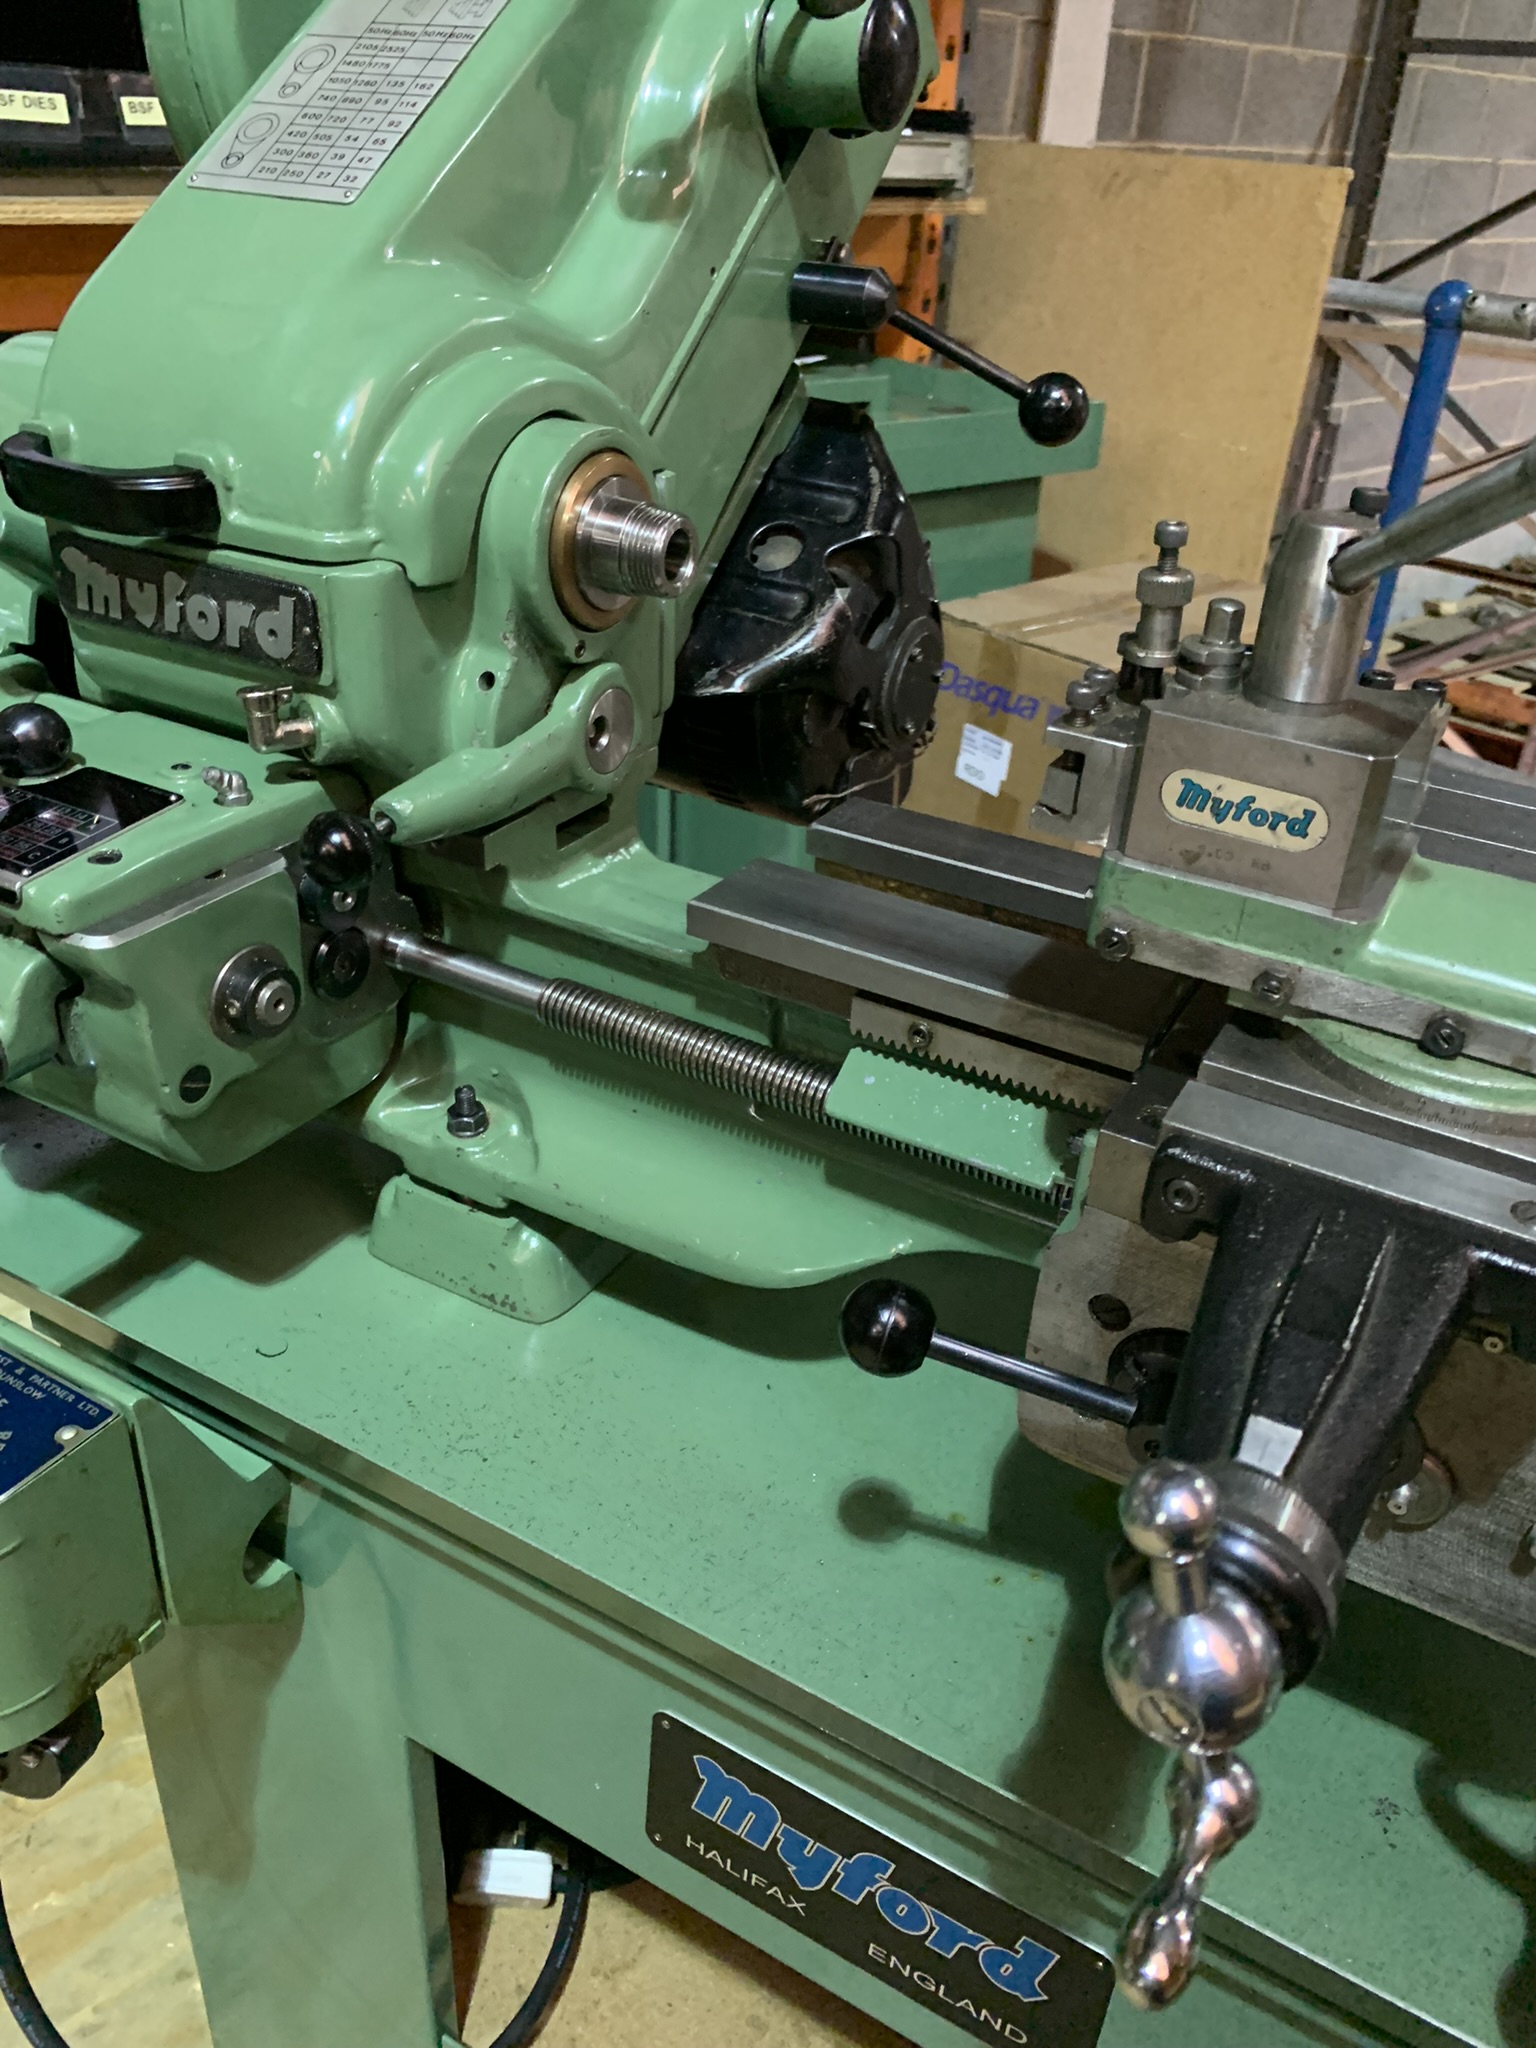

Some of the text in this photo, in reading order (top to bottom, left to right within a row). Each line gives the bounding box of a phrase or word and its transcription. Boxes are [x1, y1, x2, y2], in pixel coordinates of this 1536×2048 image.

[355, 43, 406, 54] 2105 2525
[342, 59, 391, 70] 1480 1775
[328, 77, 435, 91] 1050 1260 135 162
[22, 95, 58, 111] DIES
[127, 101, 154, 114] BSF
[317, 94, 338, 102] 740
[374, 98, 390, 106] 95
[399, 101, 417, 109] 114
[301, 113, 402, 128] 600 720 77 92
[287, 130, 387, 146] 420 505 54 65
[272, 148, 373, 164] 300 360 39 47
[258, 166, 358, 183] 210 250 27 32
[939, 660, 1040, 722] Dasqua
[0, 1368, 47, 1400] UNSLOW
[28, 1374, 76, 1403] PARTNER
[685, 1834, 807, 1917] HALIFAX
[867, 1942, 1029, 2045] ENGLAND
